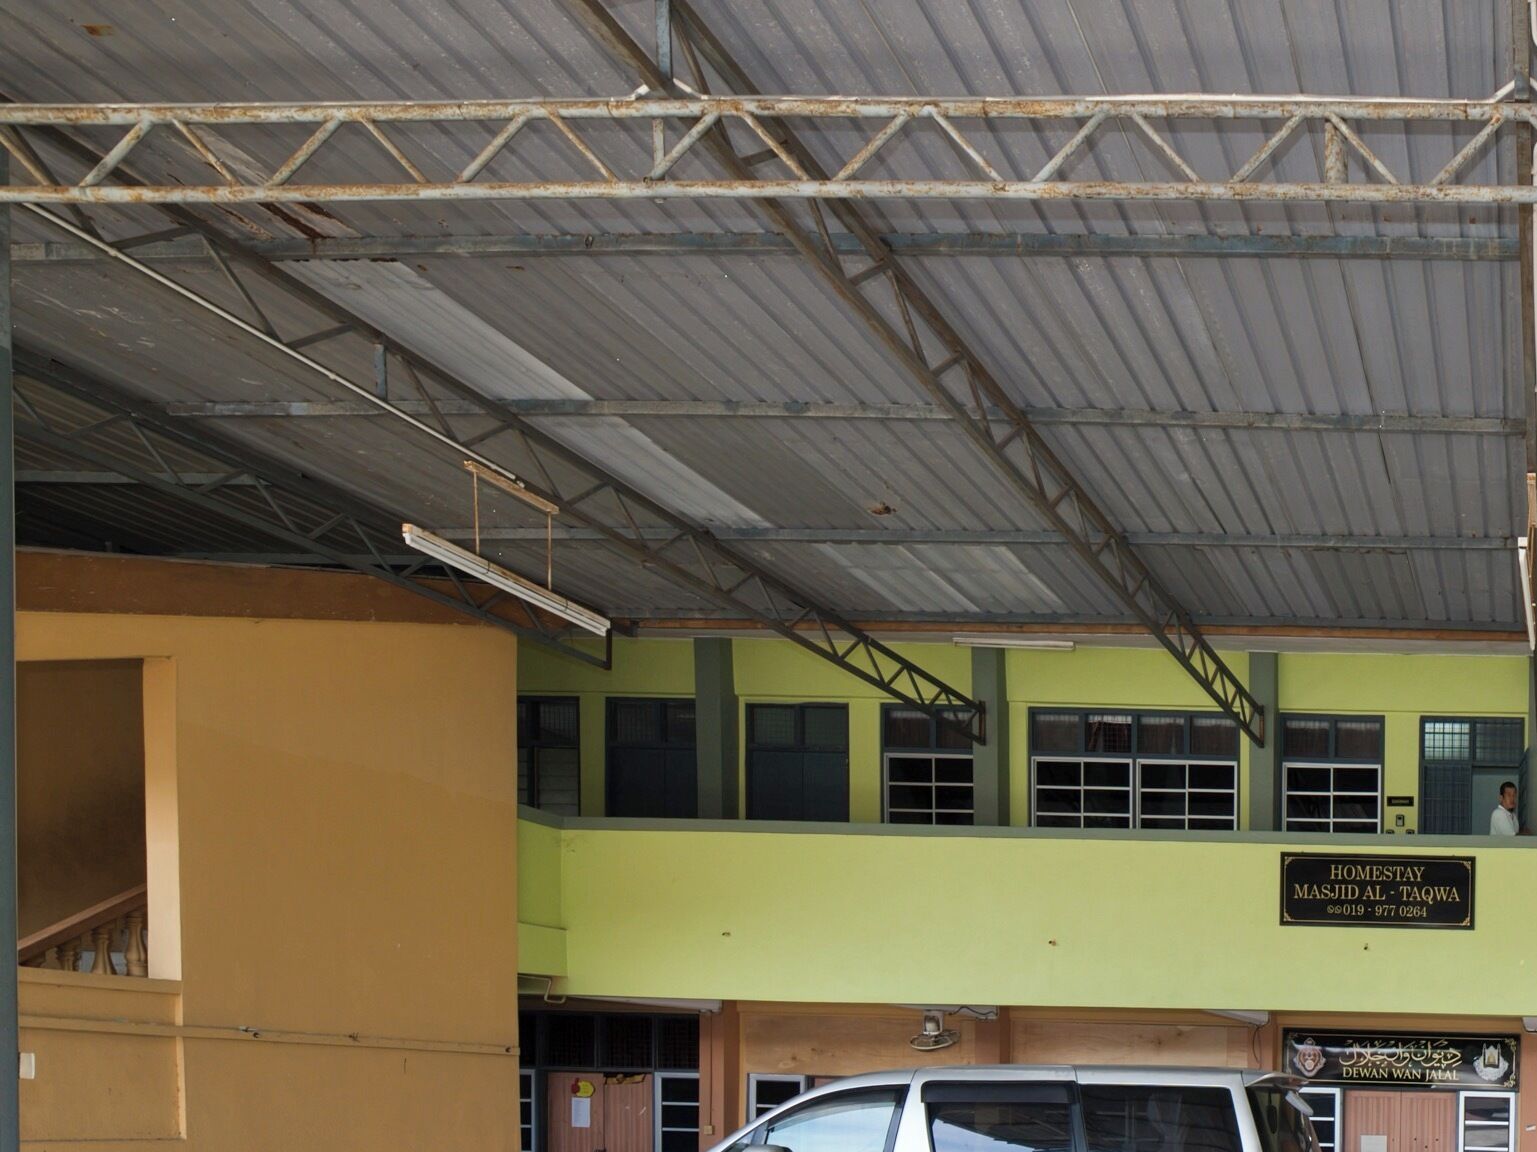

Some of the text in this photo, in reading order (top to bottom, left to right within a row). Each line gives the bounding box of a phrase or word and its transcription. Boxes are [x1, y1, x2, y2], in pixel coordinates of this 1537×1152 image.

[1329, 864, 1425, 882] HOMESTAY
[1293, 884, 1359, 900] MASJID
[1362, 885, 1386, 900] AL
[1400, 886, 1460, 904] TAQWA
[1375, 905, 1396, 917] 977
[1400, 906, 1427, 918] 0264
[1343, 1066, 1460, 1082] DEWAN WAN JALAL
